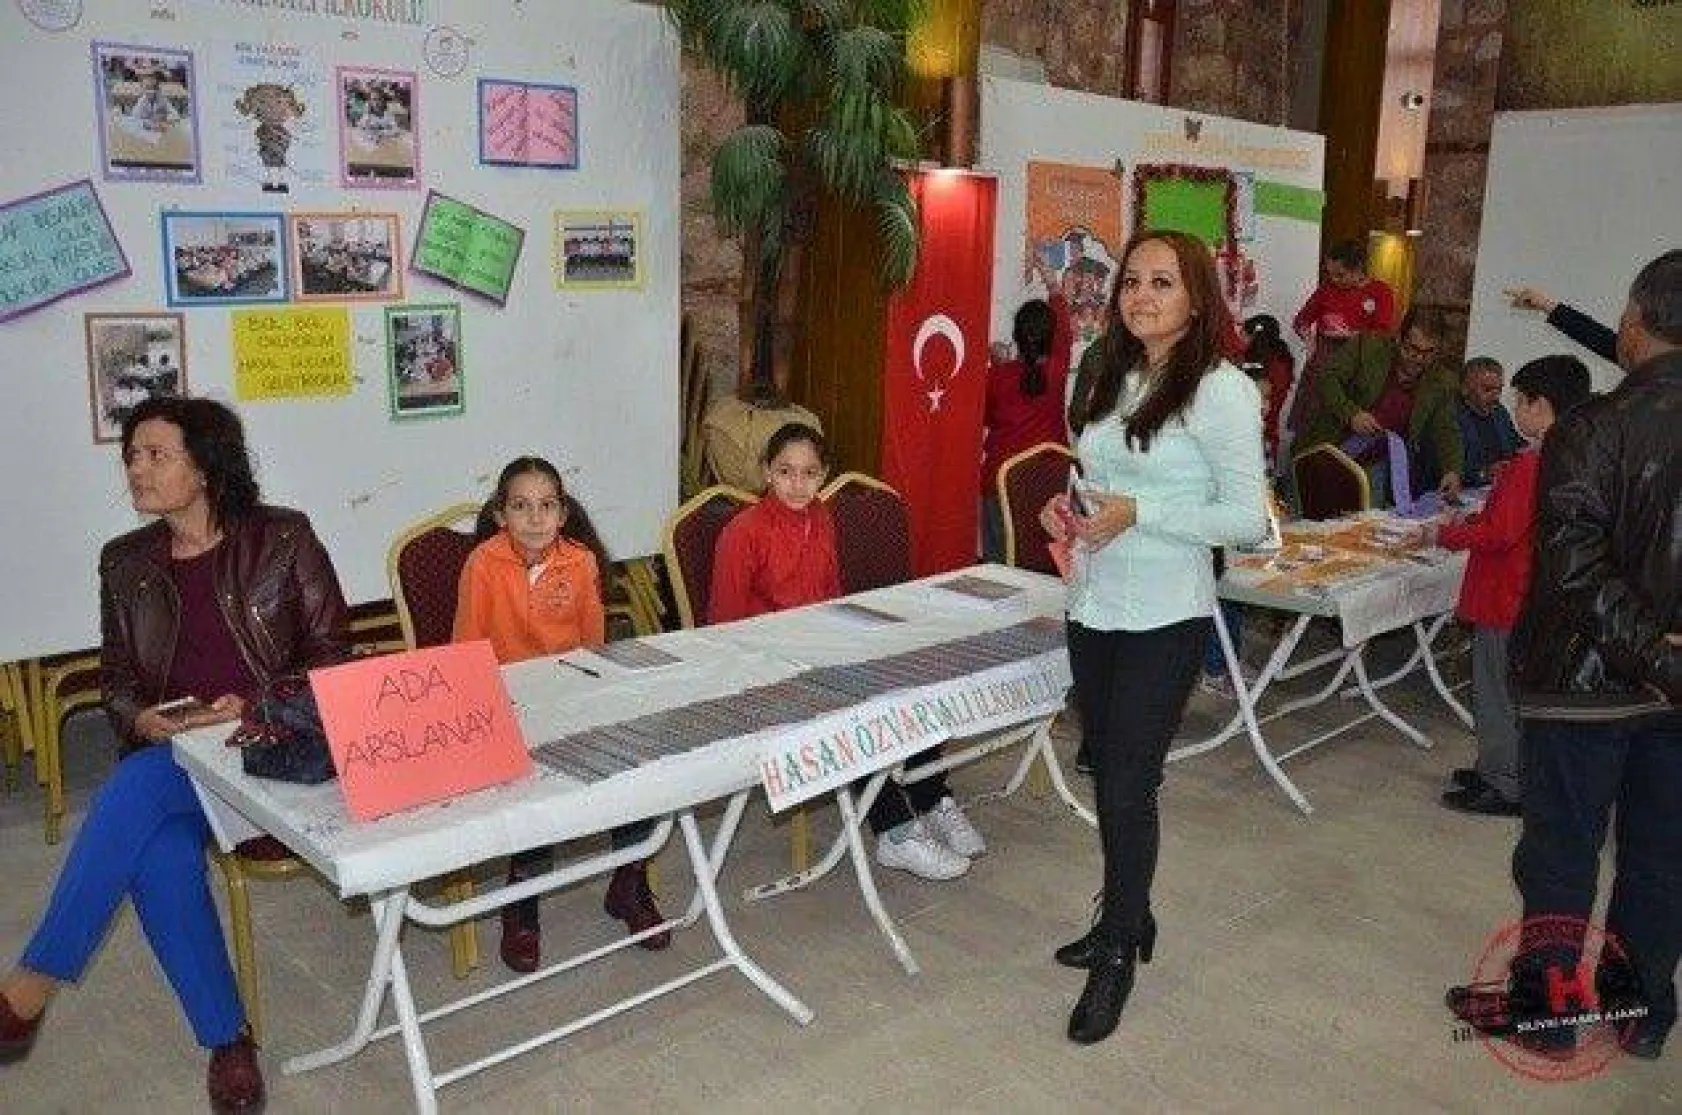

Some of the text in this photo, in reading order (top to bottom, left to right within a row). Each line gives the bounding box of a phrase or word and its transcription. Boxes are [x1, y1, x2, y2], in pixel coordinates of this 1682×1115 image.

[376, 664, 452, 711] ADA
[344, 704, 495, 777] ARSLANAY
[760, 728, 857, 798] HASAN
